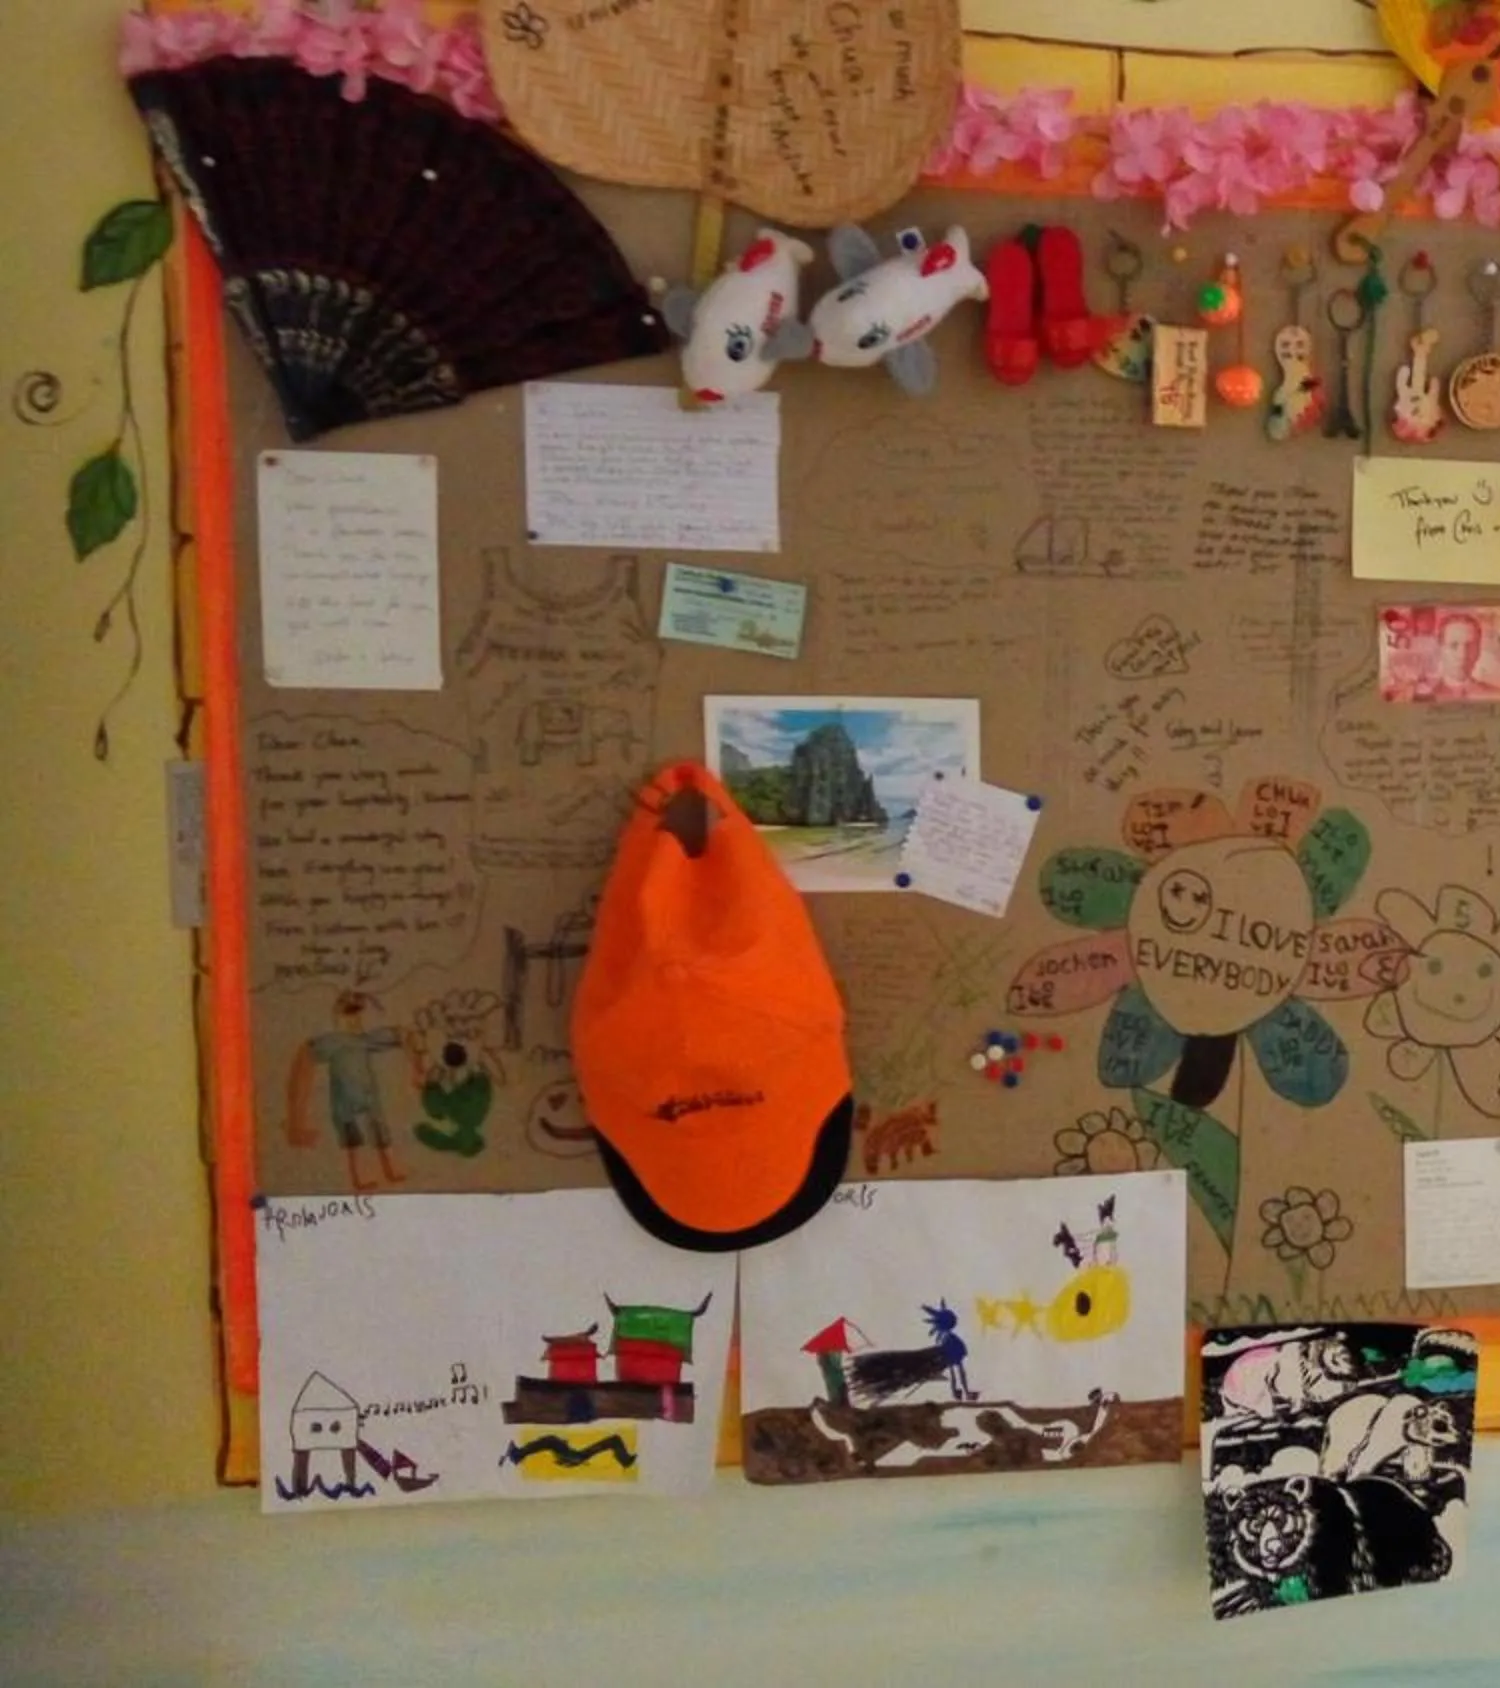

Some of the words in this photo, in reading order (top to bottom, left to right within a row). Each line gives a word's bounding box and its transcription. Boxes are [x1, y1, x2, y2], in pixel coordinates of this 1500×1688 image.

[1211, 907, 1234, 941] I
[1239, 915, 1309, 959] LOVE
[1136, 938, 1291, 996] EVERYBODY
